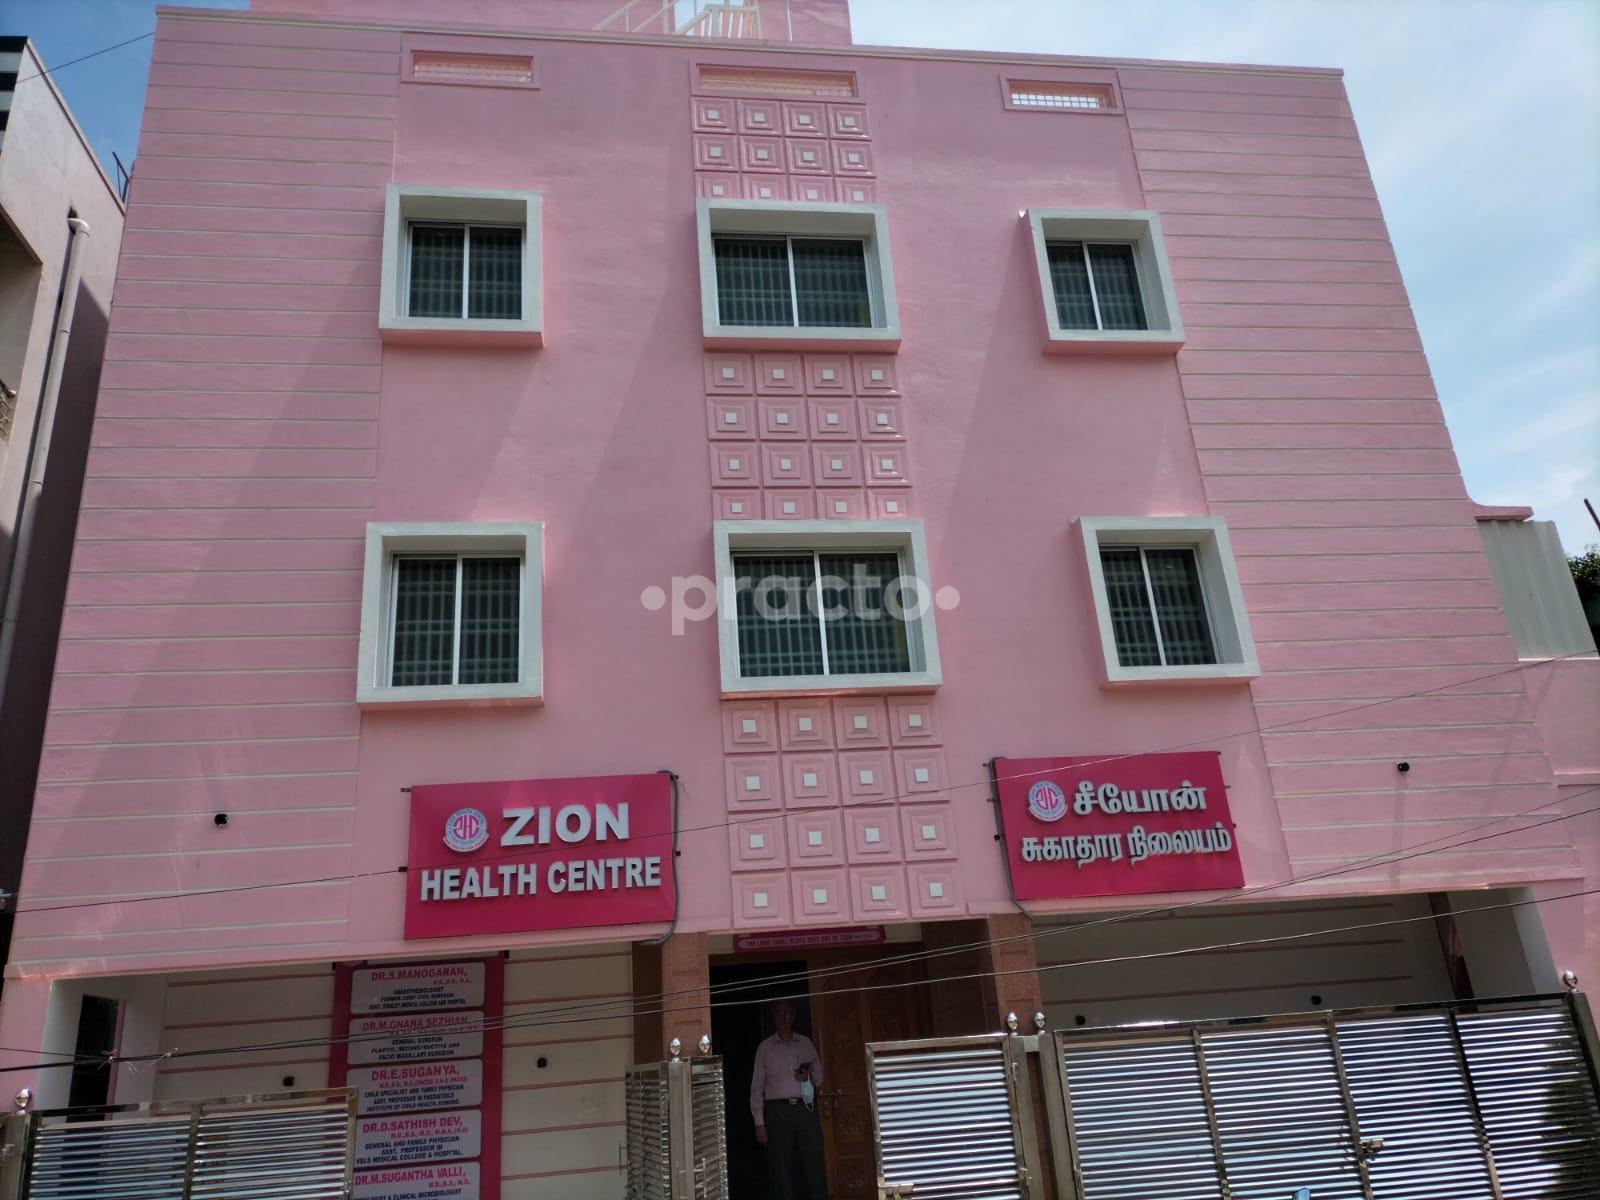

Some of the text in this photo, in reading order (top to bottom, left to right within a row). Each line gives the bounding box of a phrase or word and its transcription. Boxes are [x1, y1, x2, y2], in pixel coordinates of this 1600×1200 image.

[1073, 780, 1206, 815] சீயோன்
[500, 802, 630, 847] ZION
[1021, 822, 1232, 868] சுகாதார நிலையம்
[420, 856, 662, 901] HEALTH CENTRE
[363, 1116, 463, 1134] DR.D.SATHISH DEV,
[364, 1142, 392, 1150] GENERAL
[406, 1138, 428, 1146] FAMILY
[428, 1135, 460, 1145] PHYSICIAN
[400, 1145, 436, 1154] PROFESSOR
[372, 1154, 399, 1163] MEDICAL
[399, 1152, 427, 1161] COLLEGE
[355, 1167, 466, 1186] DR.M.SUGANTHA VALLI,
